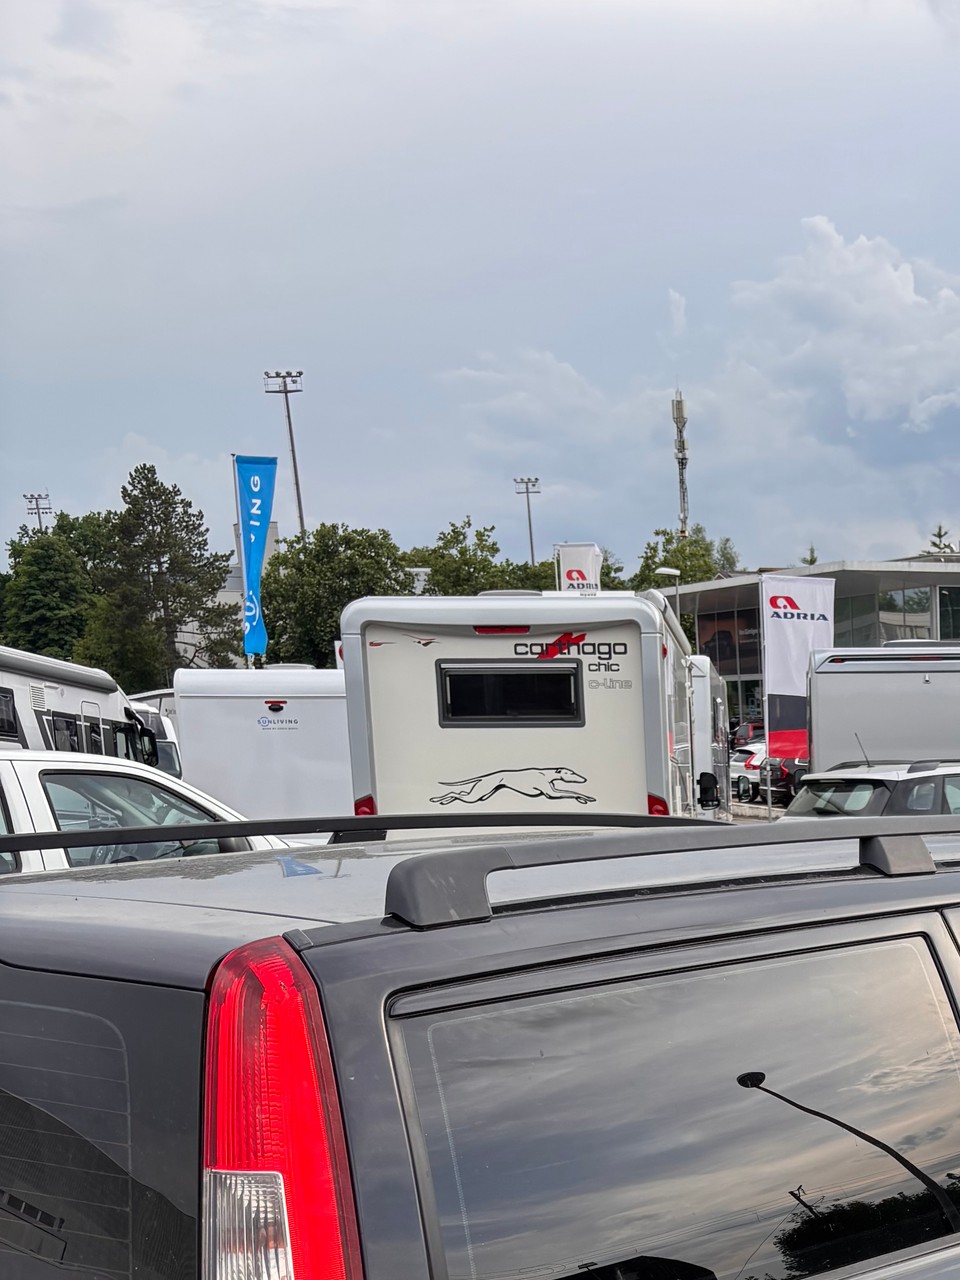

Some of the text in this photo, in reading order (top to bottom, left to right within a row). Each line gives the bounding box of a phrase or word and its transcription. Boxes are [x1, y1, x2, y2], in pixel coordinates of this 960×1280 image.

[770, 611, 829, 621] ADRIA
[514, 641, 628, 660] carthago
[588, 662, 620, 672] chic
[588, 678, 632, 689] c-line
[257, 716, 299, 727] SUNLIVING
